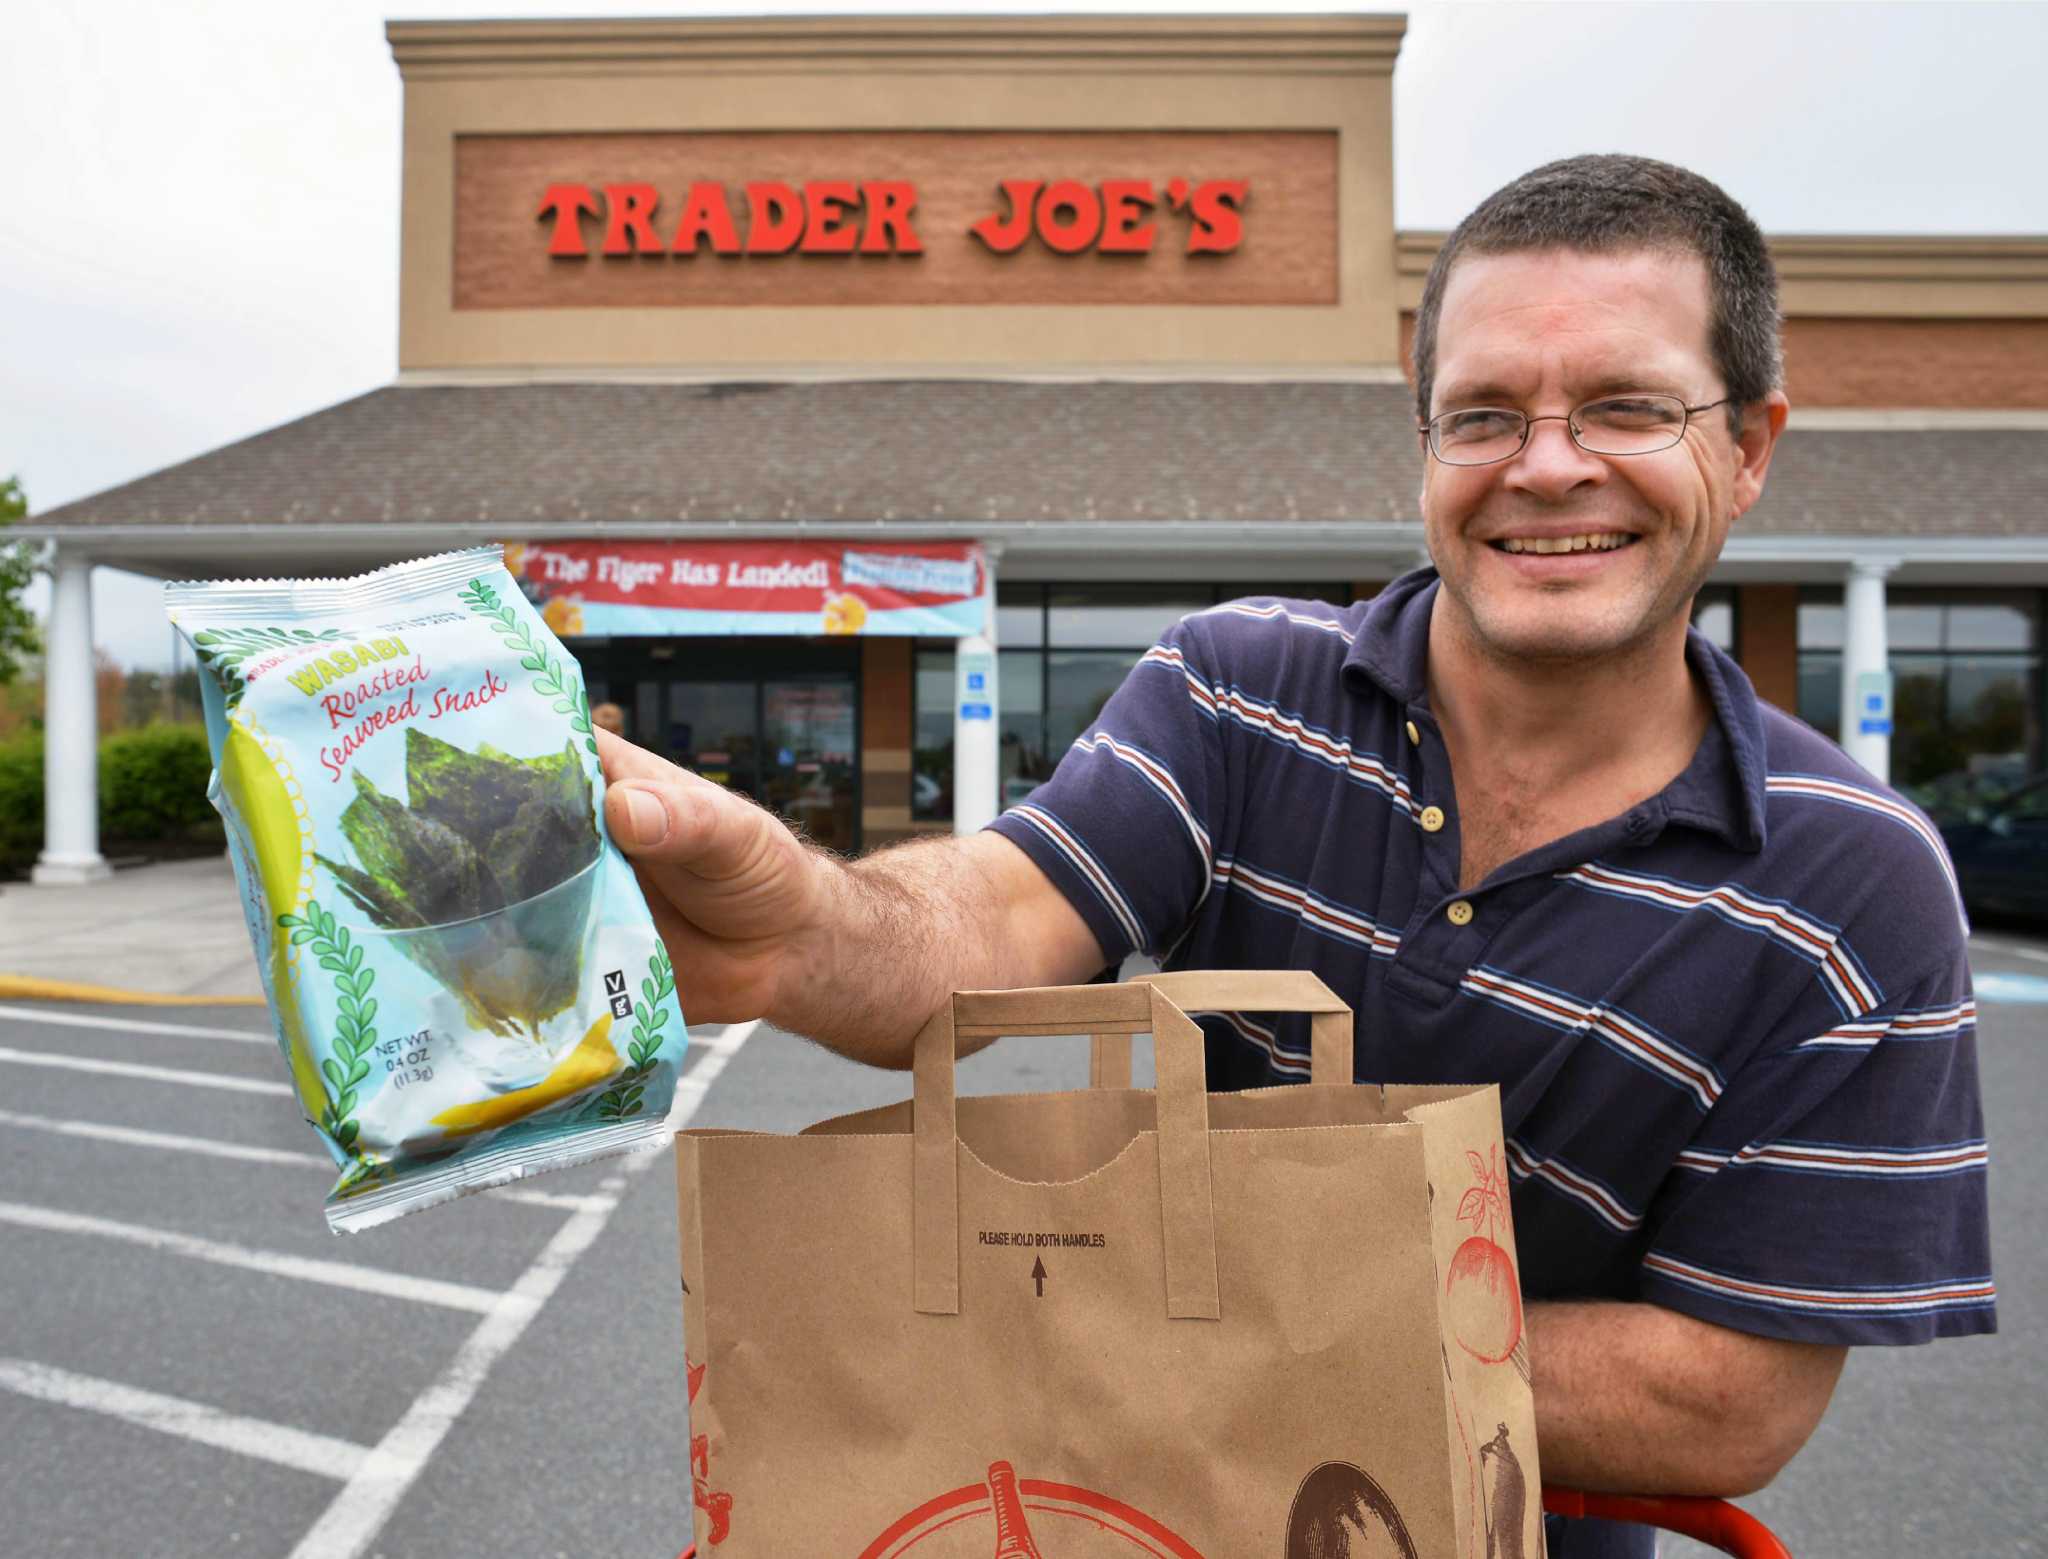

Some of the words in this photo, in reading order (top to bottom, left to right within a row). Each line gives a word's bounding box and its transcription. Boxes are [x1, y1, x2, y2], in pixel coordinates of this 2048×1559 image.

[537, 181, 924, 256] TRADER
[969, 179, 1249, 256] JOE'S
[542, 552, 589, 583] The
[670, 559, 719, 585] Has
[726, 560, 830, 588] Landed!
[287, 634, 410, 697] WASABI
[320, 654, 430, 730] Roasted
[320, 688, 421, 783] Seaweed
[428, 669, 507, 719] Snack
[375, 1038, 402, 1057] NET
[406, 1048, 431, 1065] OZ
[979, 1231, 1009, 1246] PLEASE
[1011, 1232, 1034, 1247] HOLD
[1035, 1233, 1060, 1247] BOTH
[1062, 1233, 1105, 1248] HANDLES
